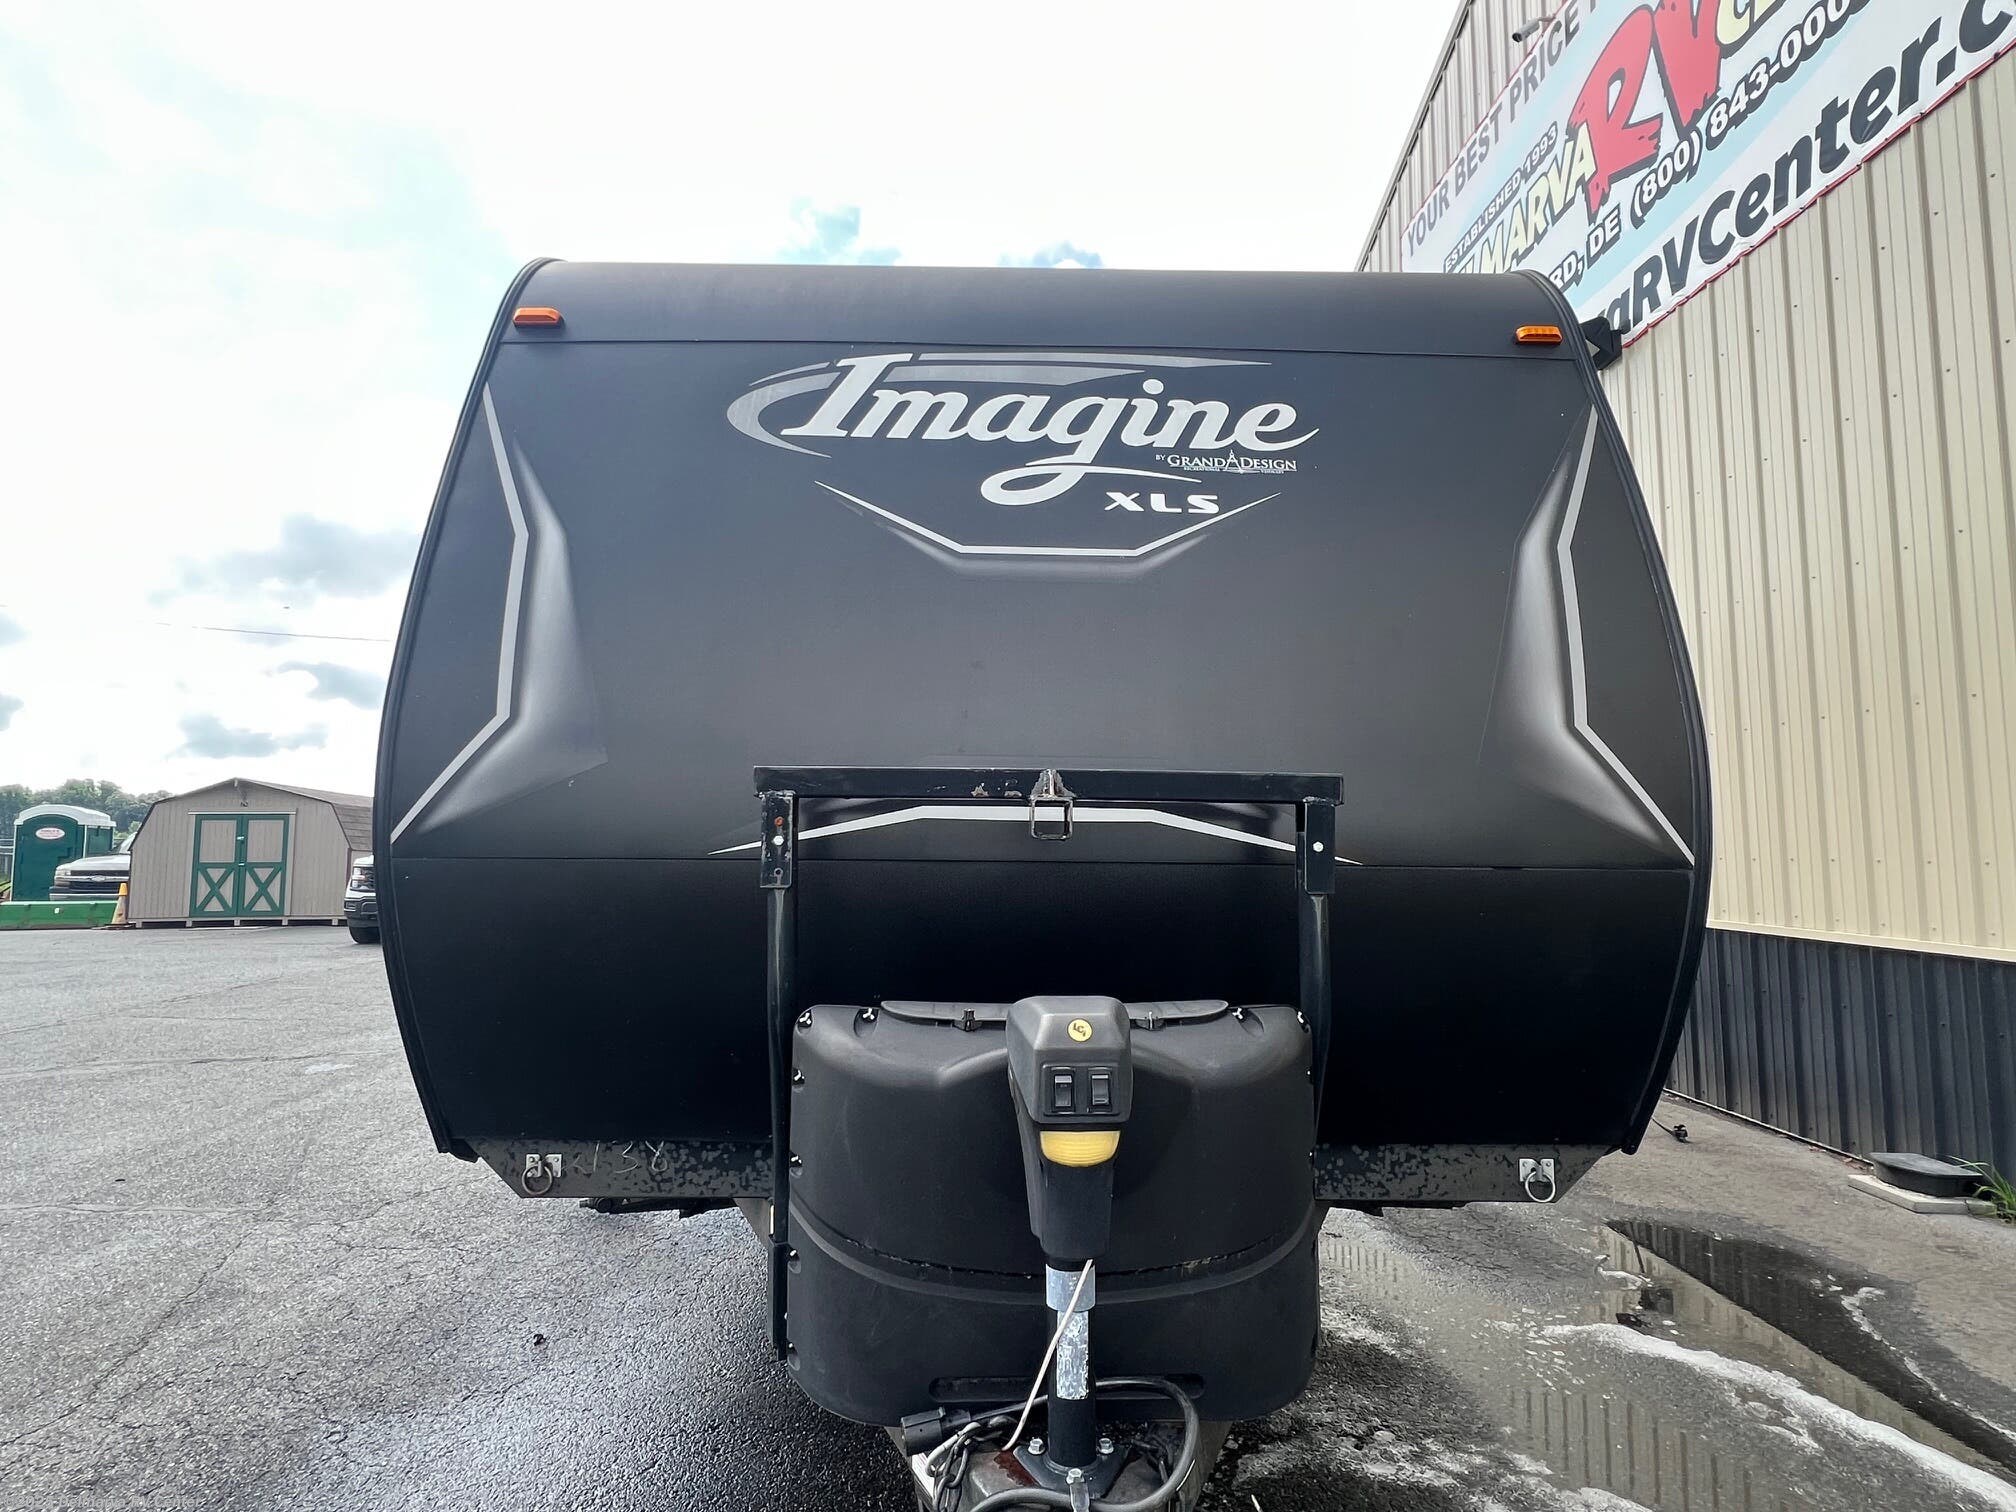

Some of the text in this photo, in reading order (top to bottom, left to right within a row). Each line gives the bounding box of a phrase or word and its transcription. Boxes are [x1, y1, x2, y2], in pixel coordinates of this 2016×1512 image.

[1407, 0, 1580, 257] YOUR BEST PRICE
[1567, 0, 1720, 223] RV
[1445, 124, 1557, 273] ESTABLISHED 1993
[1589, 206, 1620, 258] DE
[1633, 130, 1701, 218] (800)
[781, 352, 1320, 506] Imagine
[1103, 491, 1220, 514] XLS
[1167, 454, 1226, 468] GRAND
